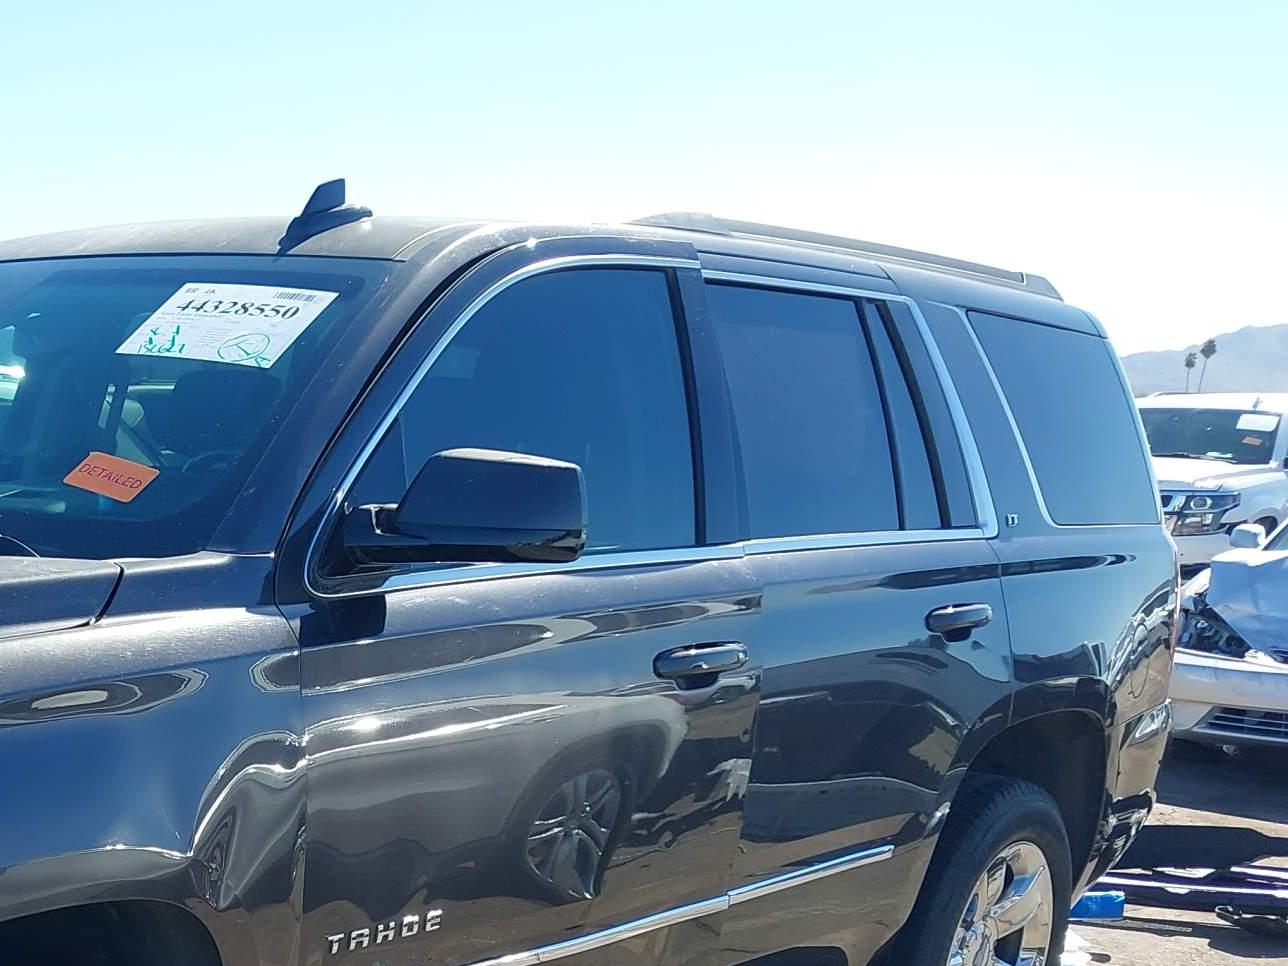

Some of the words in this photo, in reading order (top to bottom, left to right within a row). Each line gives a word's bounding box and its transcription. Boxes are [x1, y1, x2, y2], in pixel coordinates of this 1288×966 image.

[176, 299, 300, 320] 44328550
[78, 463, 143, 489] DETAILED
[327, 909, 443, 955] TAHOE
